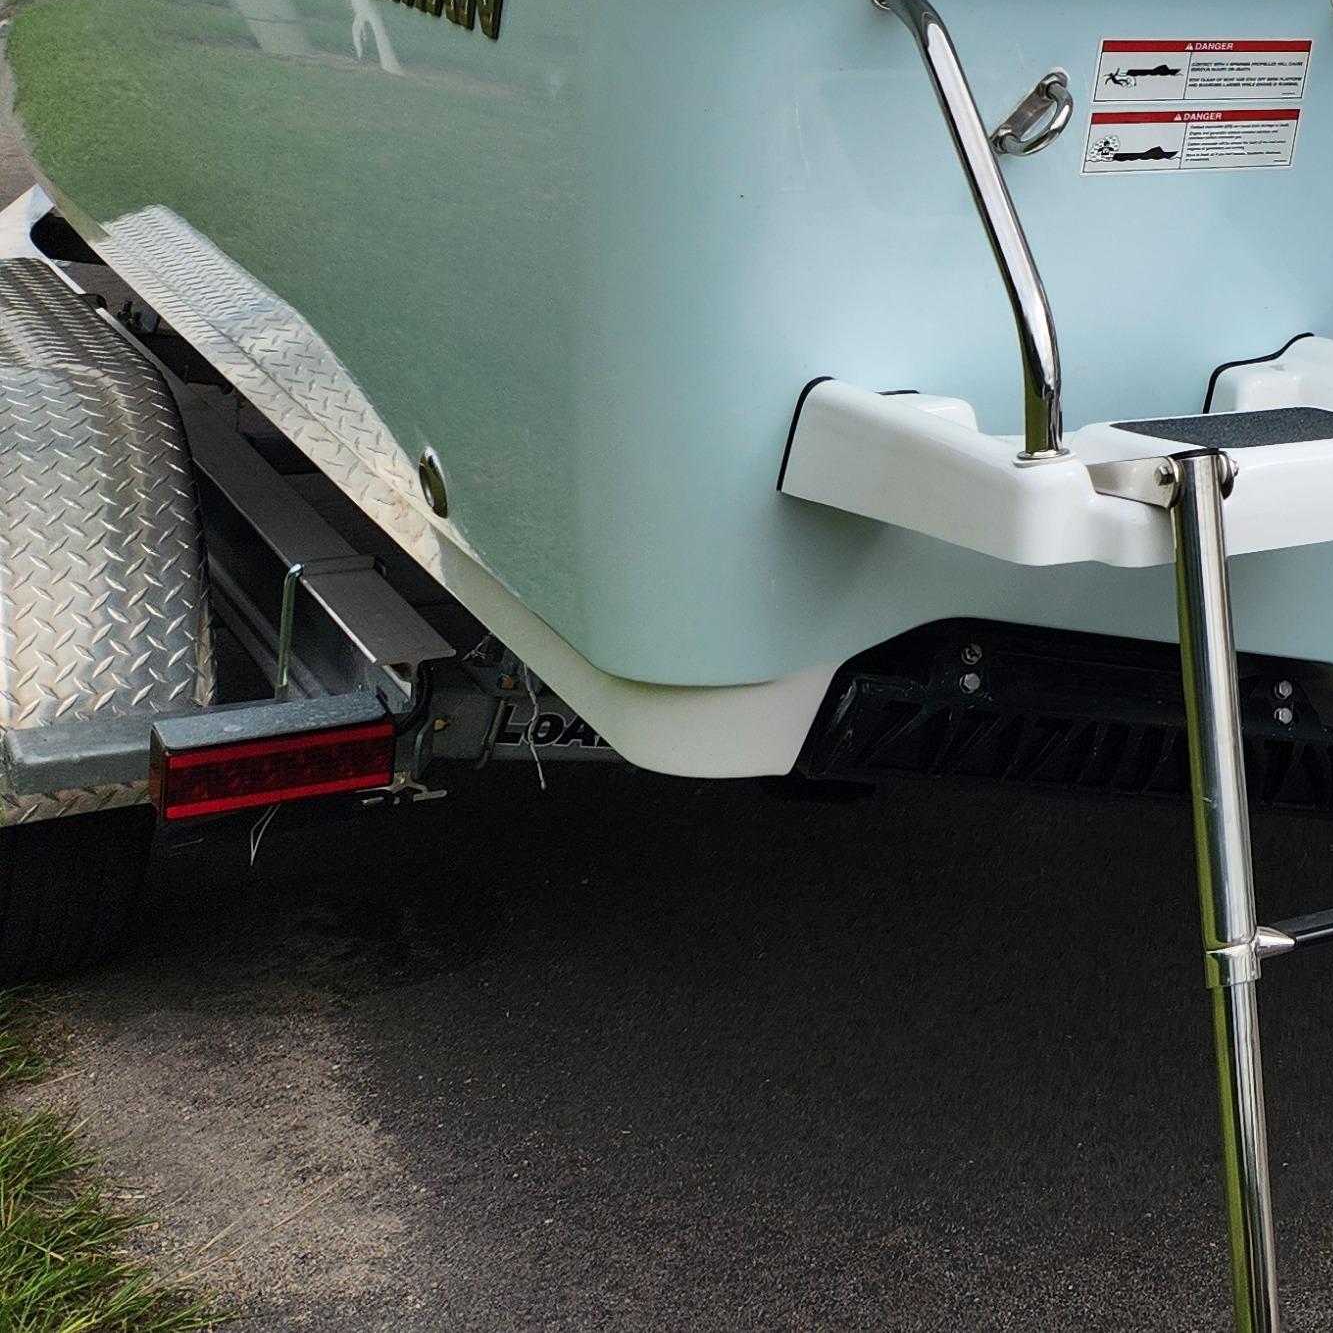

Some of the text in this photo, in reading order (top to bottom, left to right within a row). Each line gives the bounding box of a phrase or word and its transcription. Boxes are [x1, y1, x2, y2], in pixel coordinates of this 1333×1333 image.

[1194, 42, 1234, 51] DANGER
[1183, 112, 1222, 121] DANGER
[496, 703, 613, 749] LOA
